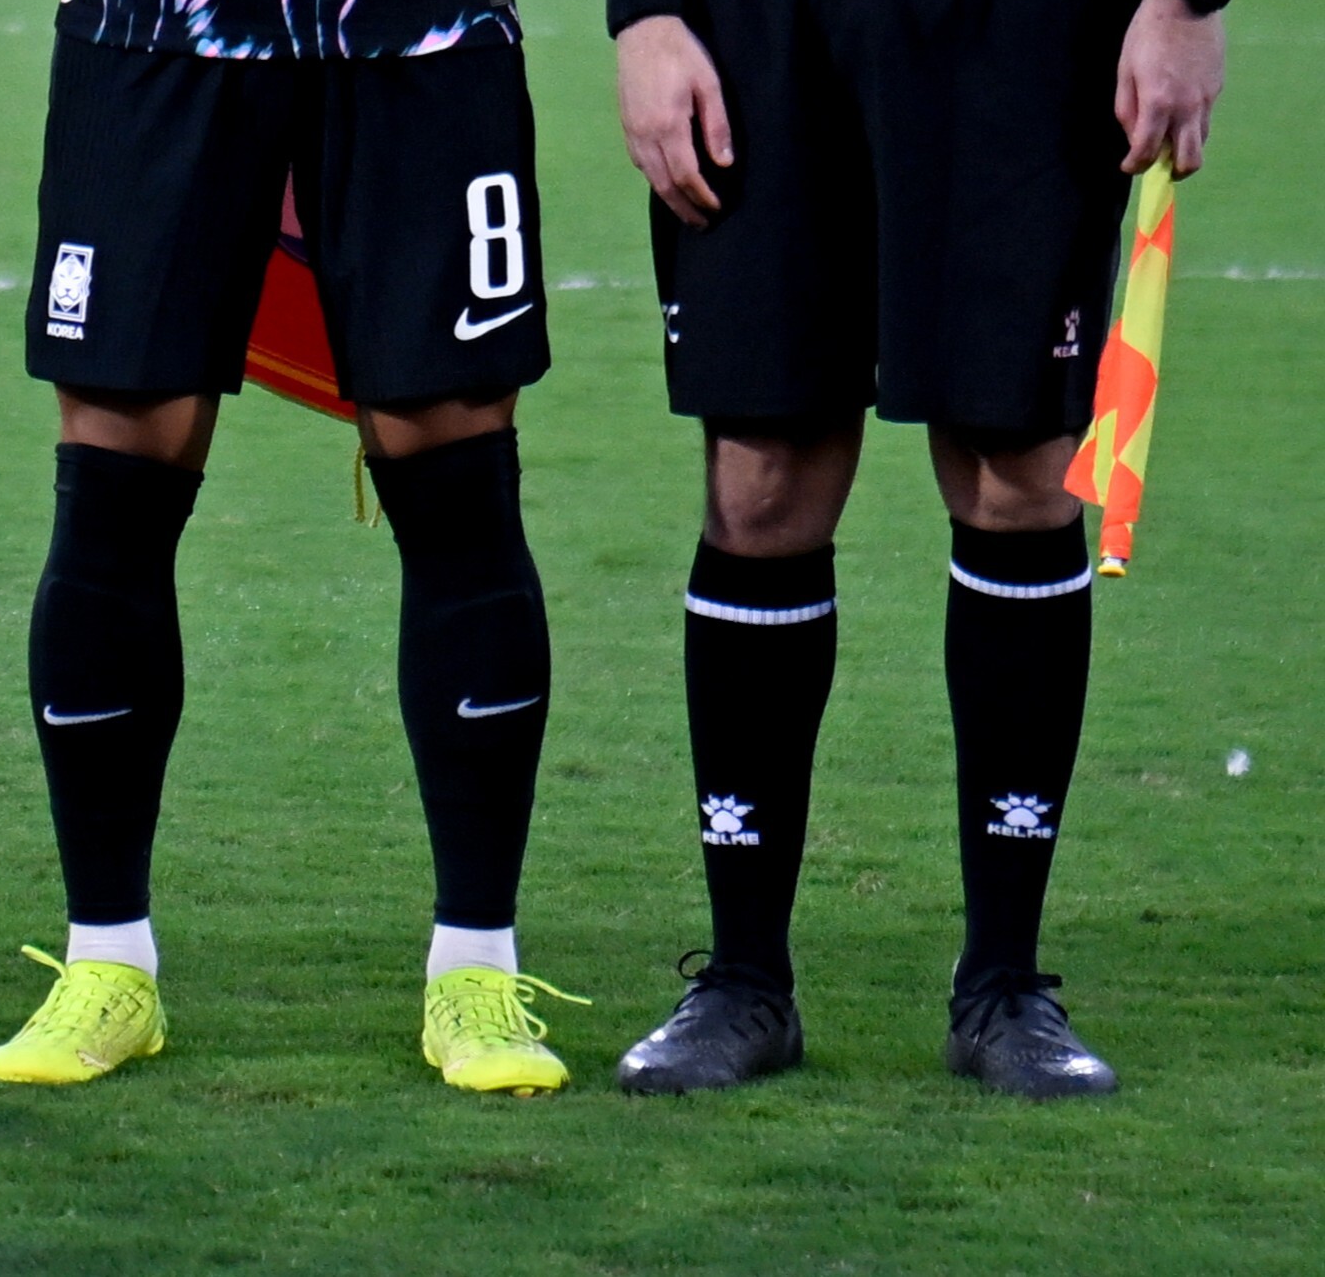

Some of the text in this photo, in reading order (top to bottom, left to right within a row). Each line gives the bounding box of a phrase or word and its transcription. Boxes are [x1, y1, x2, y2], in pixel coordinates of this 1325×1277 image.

[466, 172, 525, 300] 8
[46, 322, 84, 341] KOREA
[702, 830, 760, 846] KELME
[986, 822, 1054, 839] KELME
